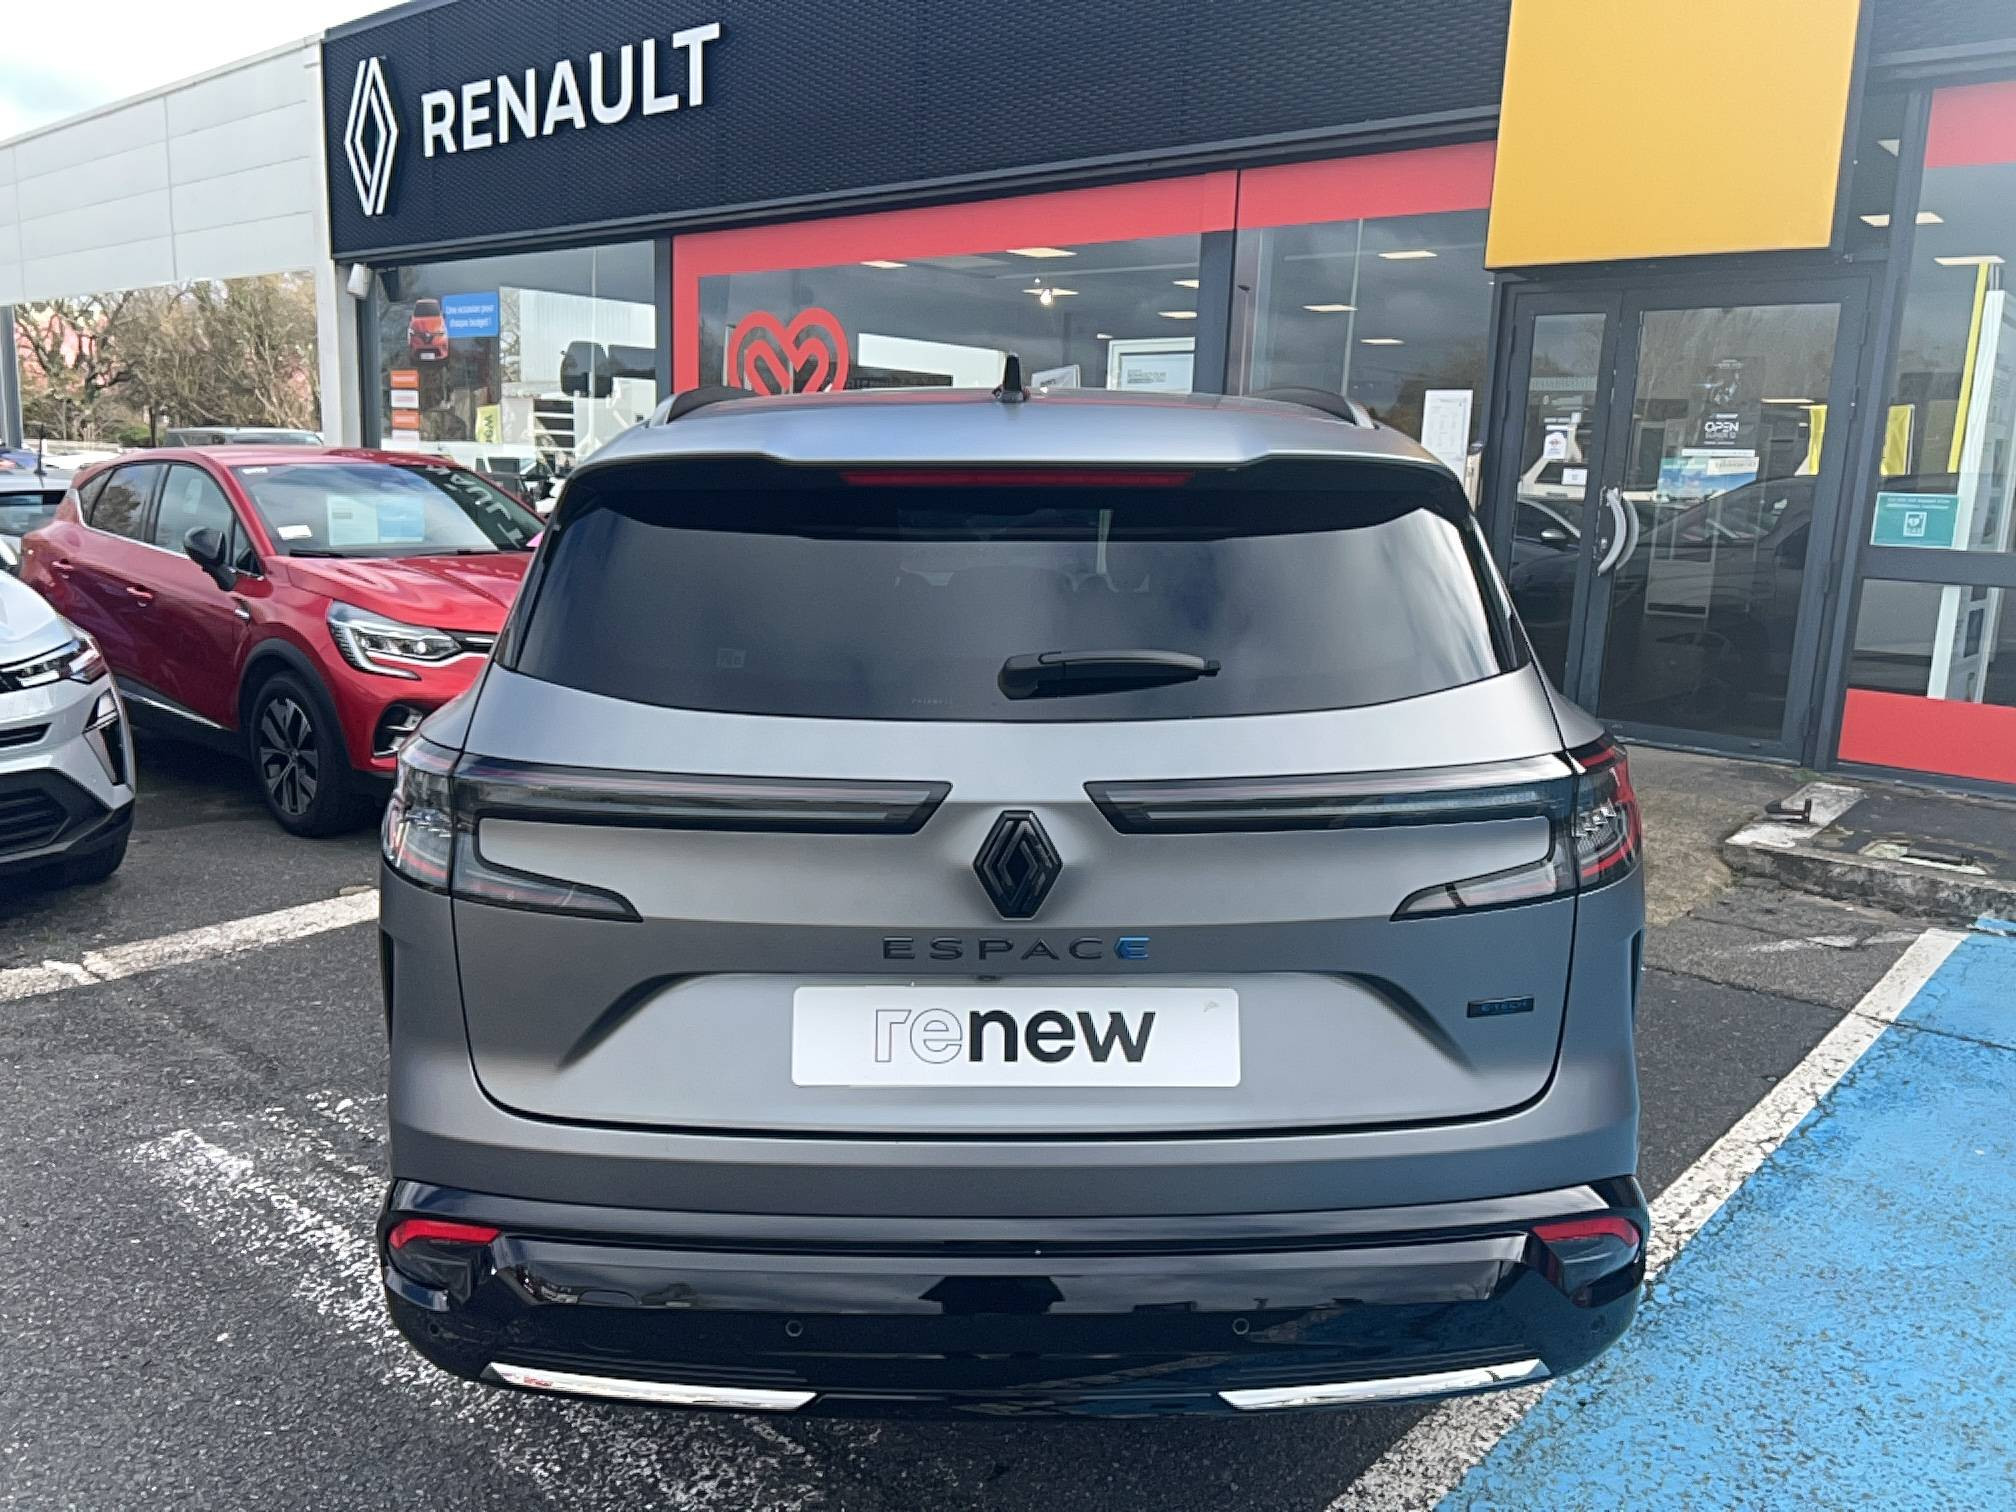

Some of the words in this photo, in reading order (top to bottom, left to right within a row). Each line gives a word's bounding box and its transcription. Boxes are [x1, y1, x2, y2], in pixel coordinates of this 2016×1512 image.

[421, 22, 721, 158] RENAULT
[1705, 421, 1739, 433] OPEN
[882, 936, 1151, 960] ESPACE
[874, 1008, 1156, 1064] renew
